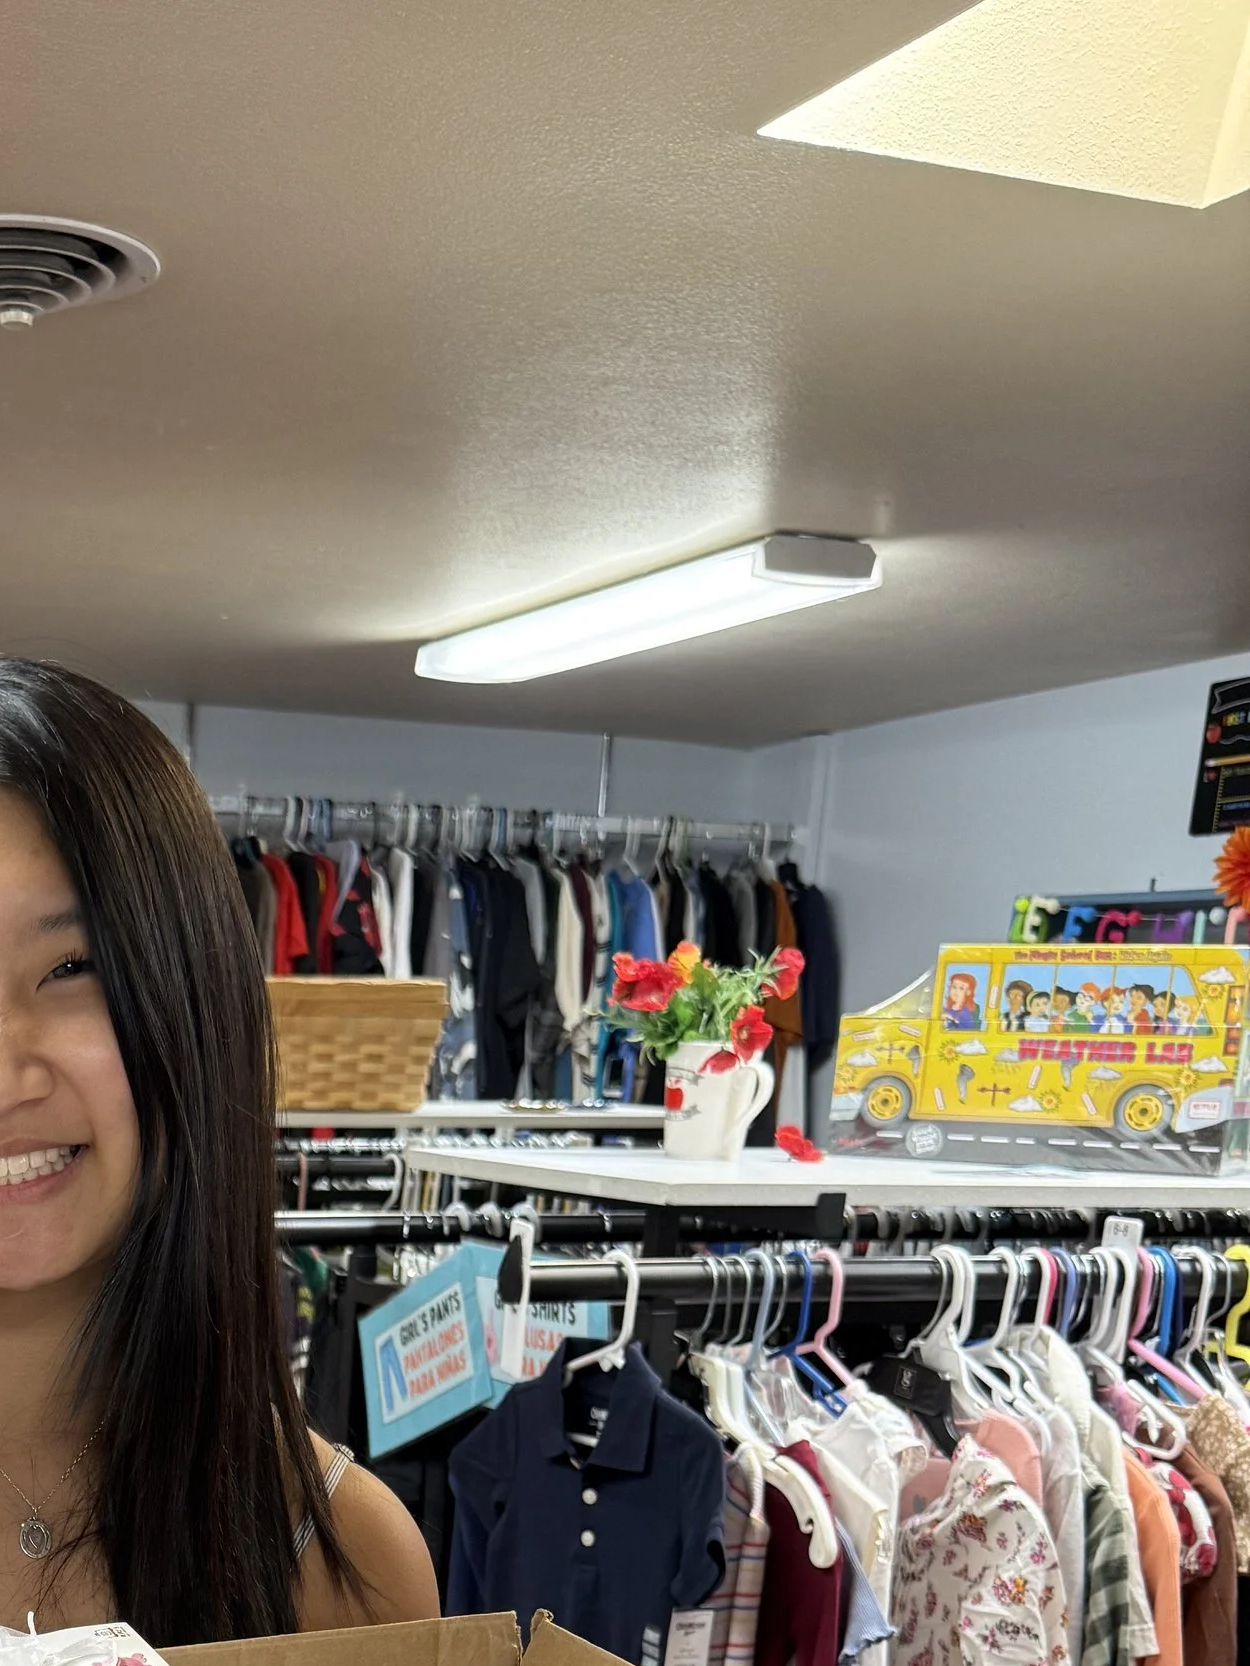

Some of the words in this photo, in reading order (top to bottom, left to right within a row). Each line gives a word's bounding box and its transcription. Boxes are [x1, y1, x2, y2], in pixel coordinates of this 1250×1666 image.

[1018, 1039, 1137, 1063] WEATHER
[1145, 1041, 1194, 1065] LAB
[429, 1291, 461, 1328] PANTS
[408, 1368, 436, 1398] PARA
